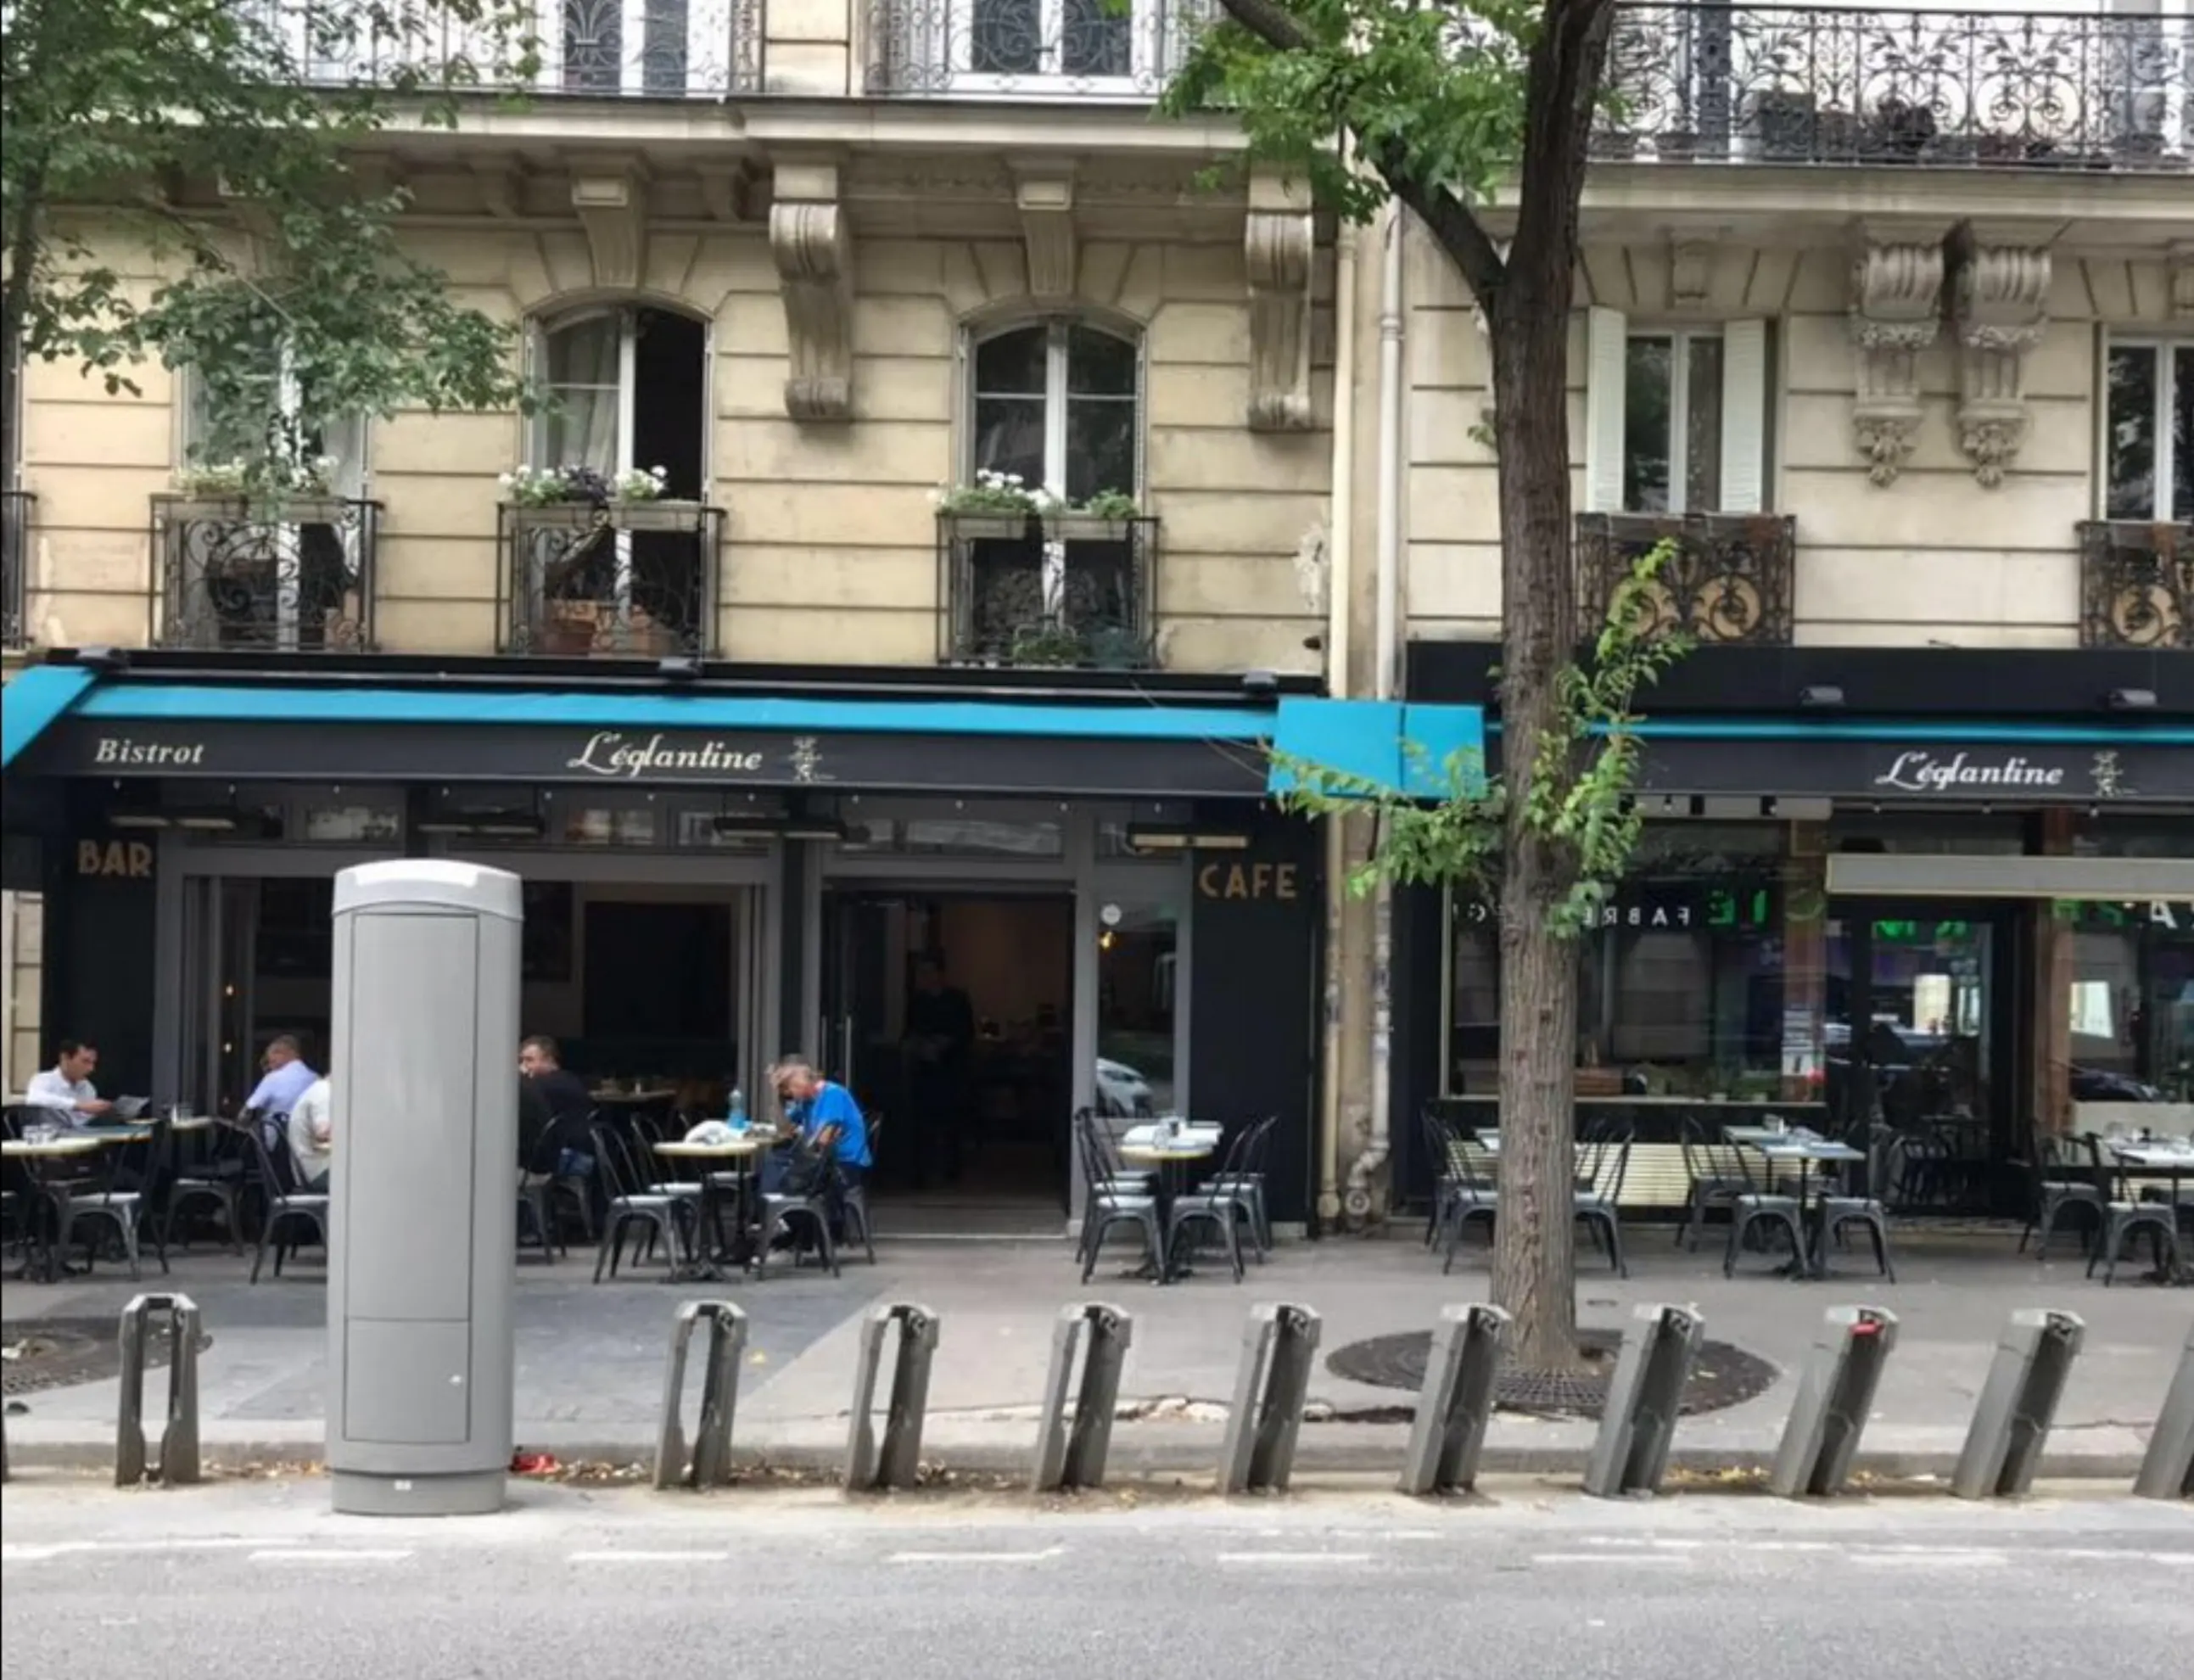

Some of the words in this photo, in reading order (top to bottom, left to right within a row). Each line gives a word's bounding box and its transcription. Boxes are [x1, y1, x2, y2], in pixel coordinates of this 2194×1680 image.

[94, 737, 204, 764] Bistrot
[566, 730, 763, 779] L'églantine
[1874, 751, 2064, 791] L'églantine
[77, 838, 153, 877] BAR
[1199, 863, 1297, 899] CAFE
